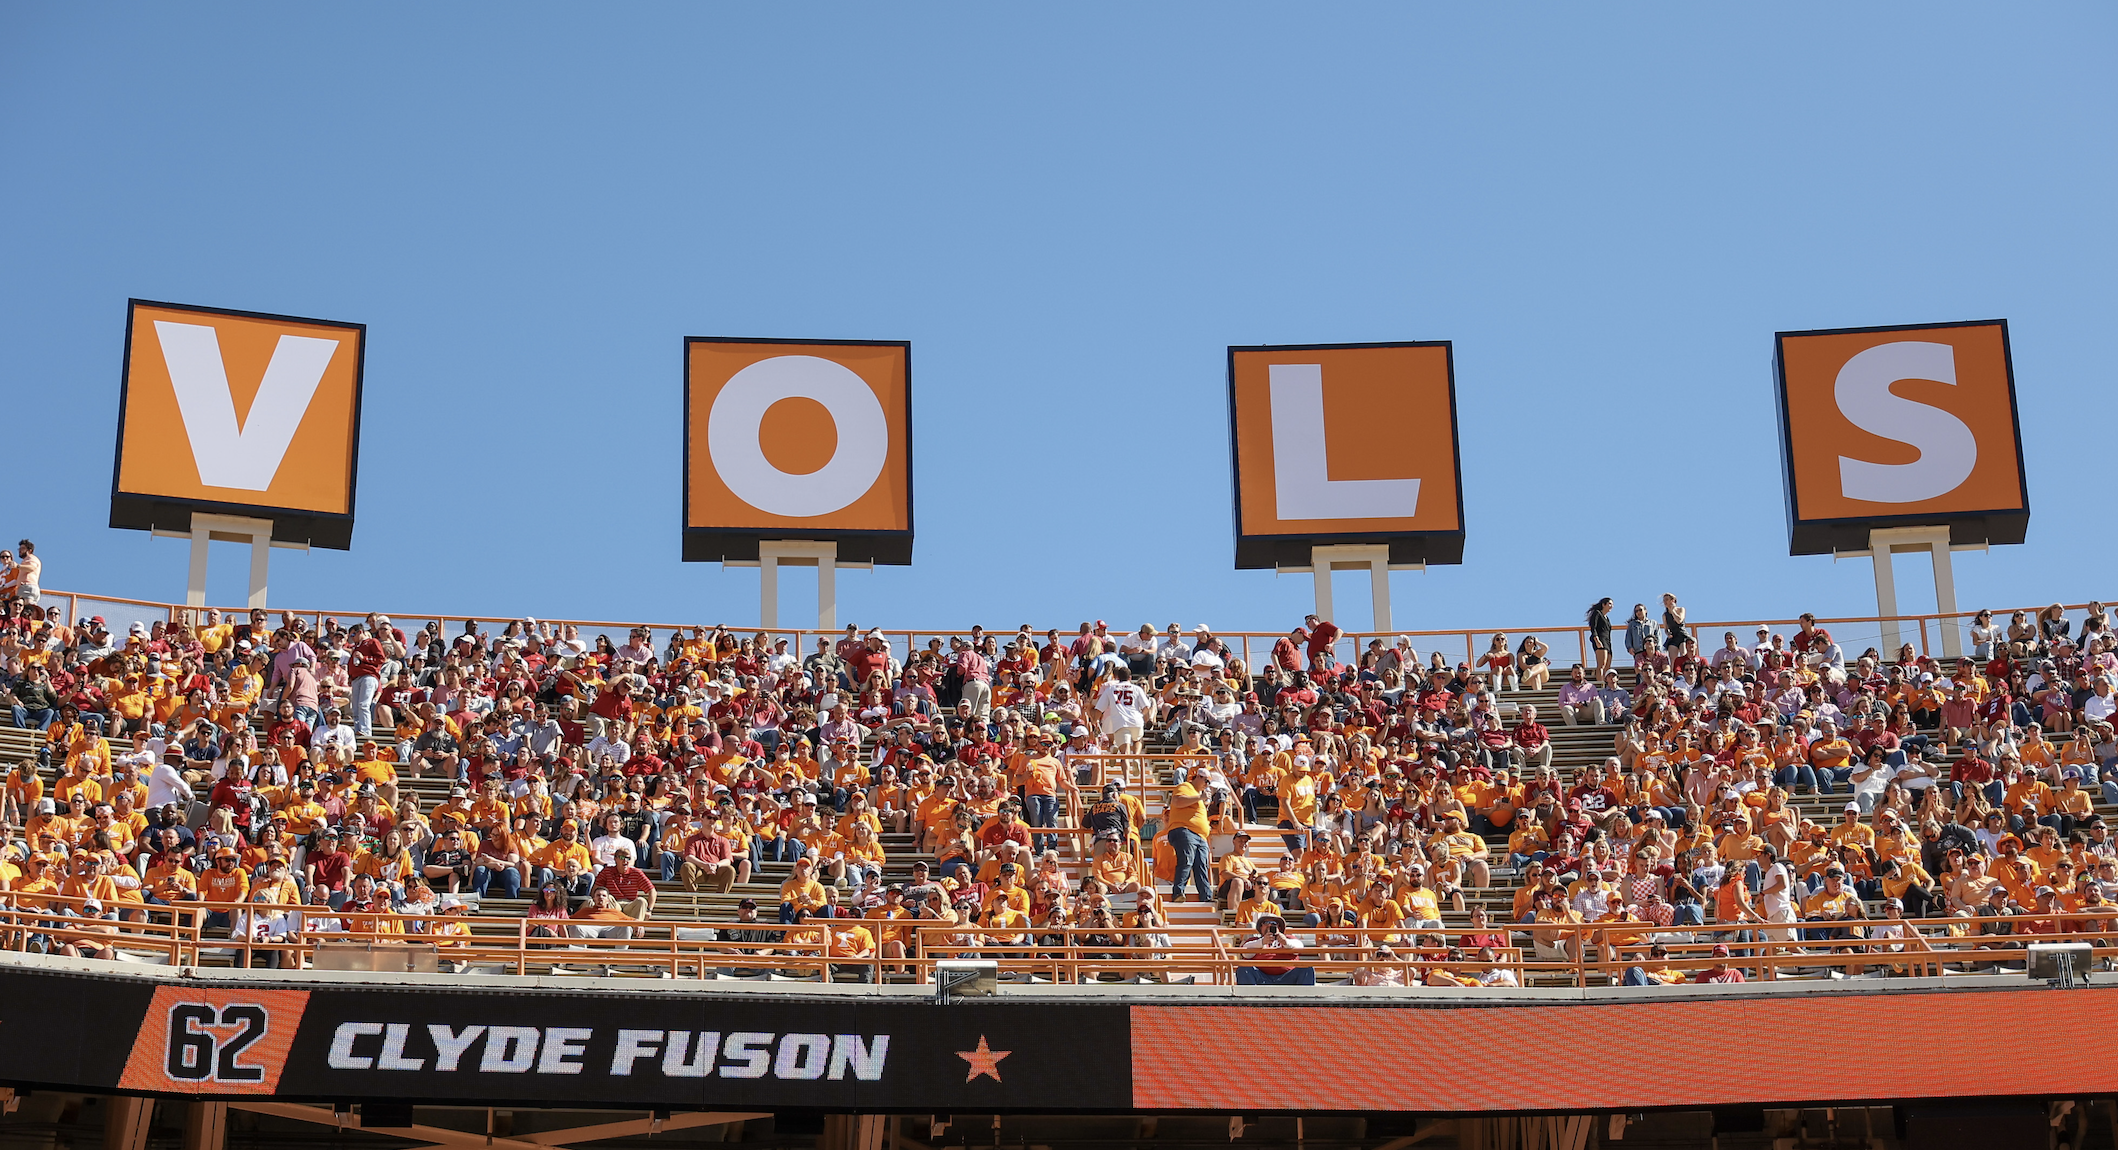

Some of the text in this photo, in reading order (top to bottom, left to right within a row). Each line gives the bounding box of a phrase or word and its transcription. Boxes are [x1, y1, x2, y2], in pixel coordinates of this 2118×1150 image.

[153, 320, 340, 492] V
[1834, 341, 1978, 504] S
[707, 355, 889, 517] O
[1268, 363, 1422, 521] L
[392, 692, 412, 704] 10
[1113, 690, 1133, 706] 75
[1581, 793, 1605, 809] 22
[1092, 807, 1117, 815] STAFF
[1436, 869, 1451, 882] T
[1313, 892, 1330, 903] T
[257, 925, 269, 936] 2
[835, 931, 855, 947] T
[164, 1001, 891, 1083] 62 CLYDE FUSON
